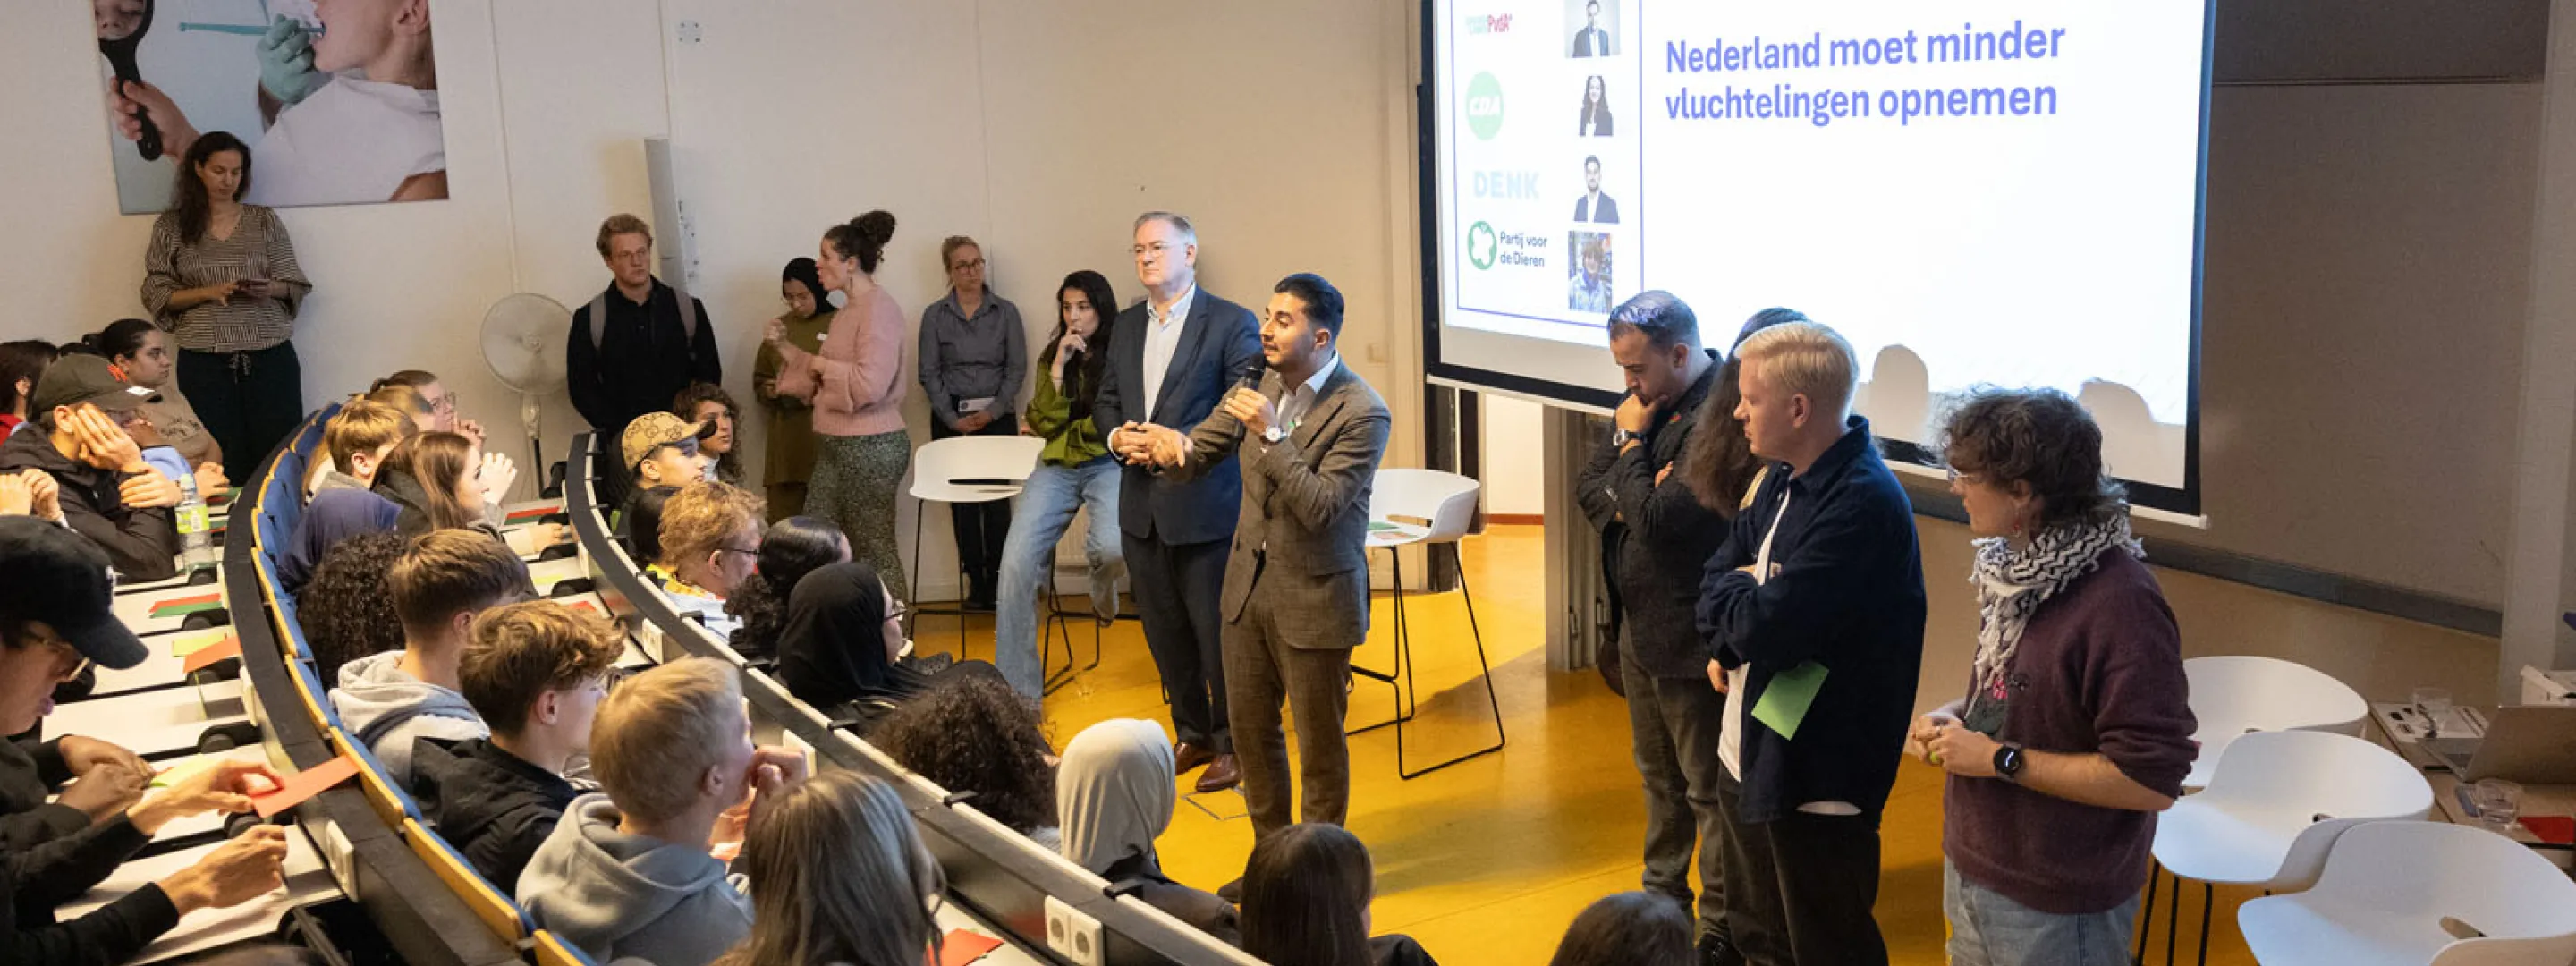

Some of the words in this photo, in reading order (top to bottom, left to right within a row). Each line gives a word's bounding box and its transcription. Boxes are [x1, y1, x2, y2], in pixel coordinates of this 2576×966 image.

[1666, 32, 1819, 73] Nederland
[1830, 30, 1918, 66] moet
[1927, 20, 2065, 63] minder
[1469, 96, 1500, 116] CDA
[1665, 84, 1869, 127] vluchtelingen
[1879, 86, 2056, 126] opnemen
[1473, 170, 1540, 199] DENK
[1500, 231, 1524, 250] Partij
[1526, 236, 1547, 248] voor
[1500, 250, 1512, 265] de
[1513, 251, 1545, 267] Dieren
